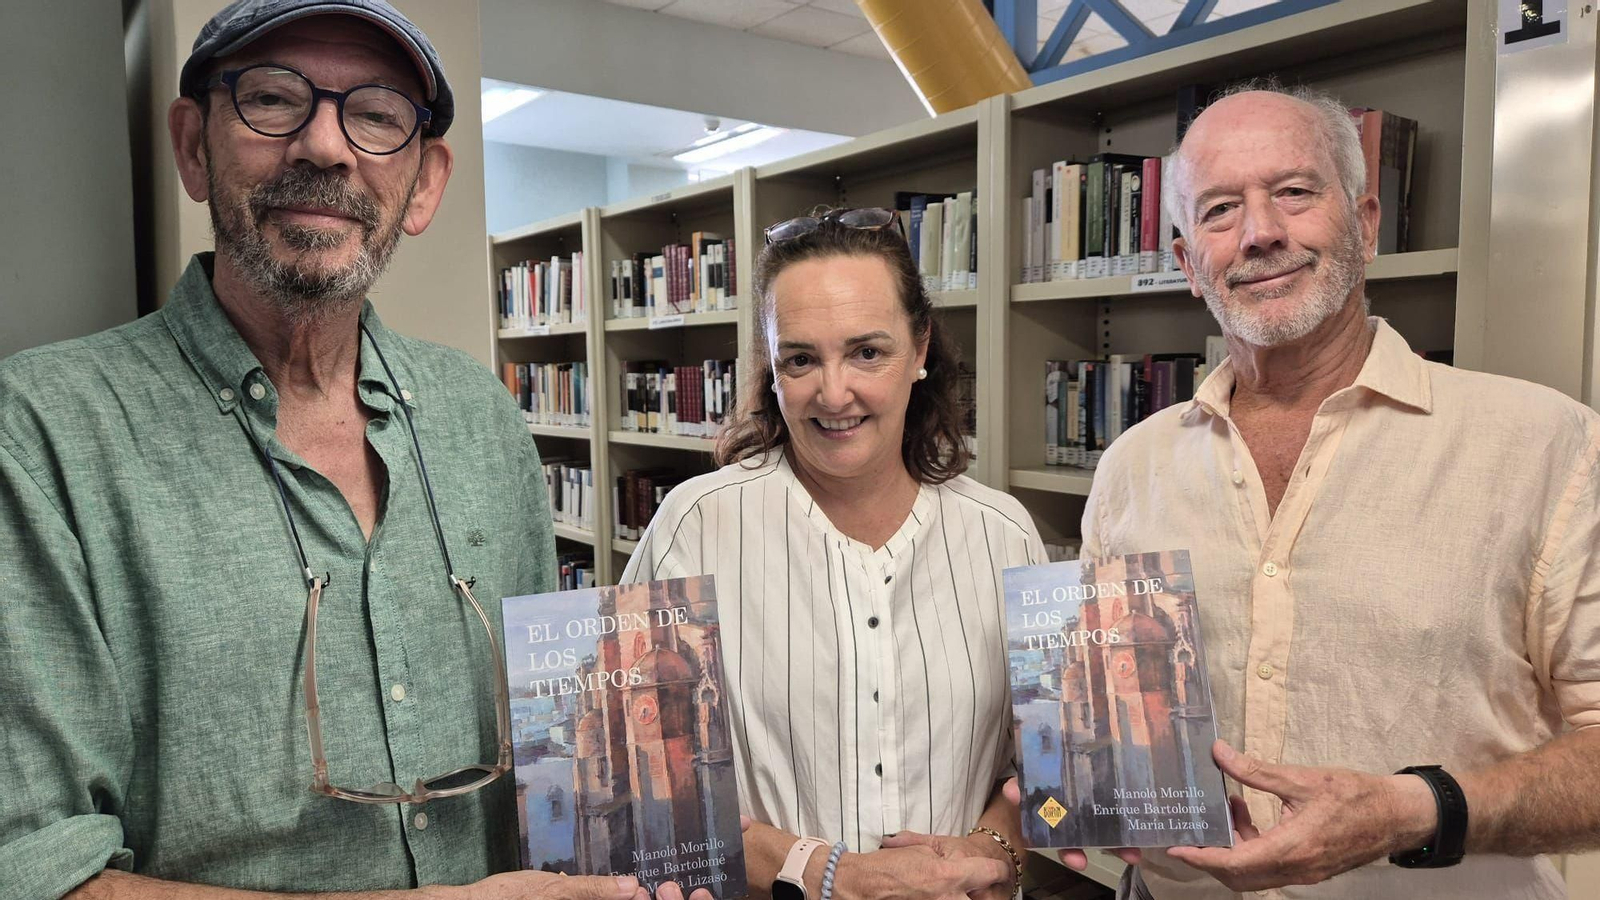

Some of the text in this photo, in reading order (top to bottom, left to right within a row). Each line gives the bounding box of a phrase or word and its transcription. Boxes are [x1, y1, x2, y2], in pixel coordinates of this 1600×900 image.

[1137, 278, 1154, 286] 892
[1159, 277, 1188, 285] LITERATUR
[1021, 578, 1163, 606] EL ORDEN DE
[527, 606, 689, 644] EL ORDEN DE
[1022, 610, 1062, 629] LOS
[1023, 627, 1121, 651] TIEMPOS
[528, 648, 577, 672] LOS
[530, 666, 642, 699] TIEMPOS
[1113, 786, 1204, 799] Manolo Morillo
[1093, 802, 1207, 817] Enrique Bartolomé
[1127, 817, 1164, 831] María
[632, 837, 725, 863] Manolo Morillo
[610, 853, 726, 881] ique Bartolomé
